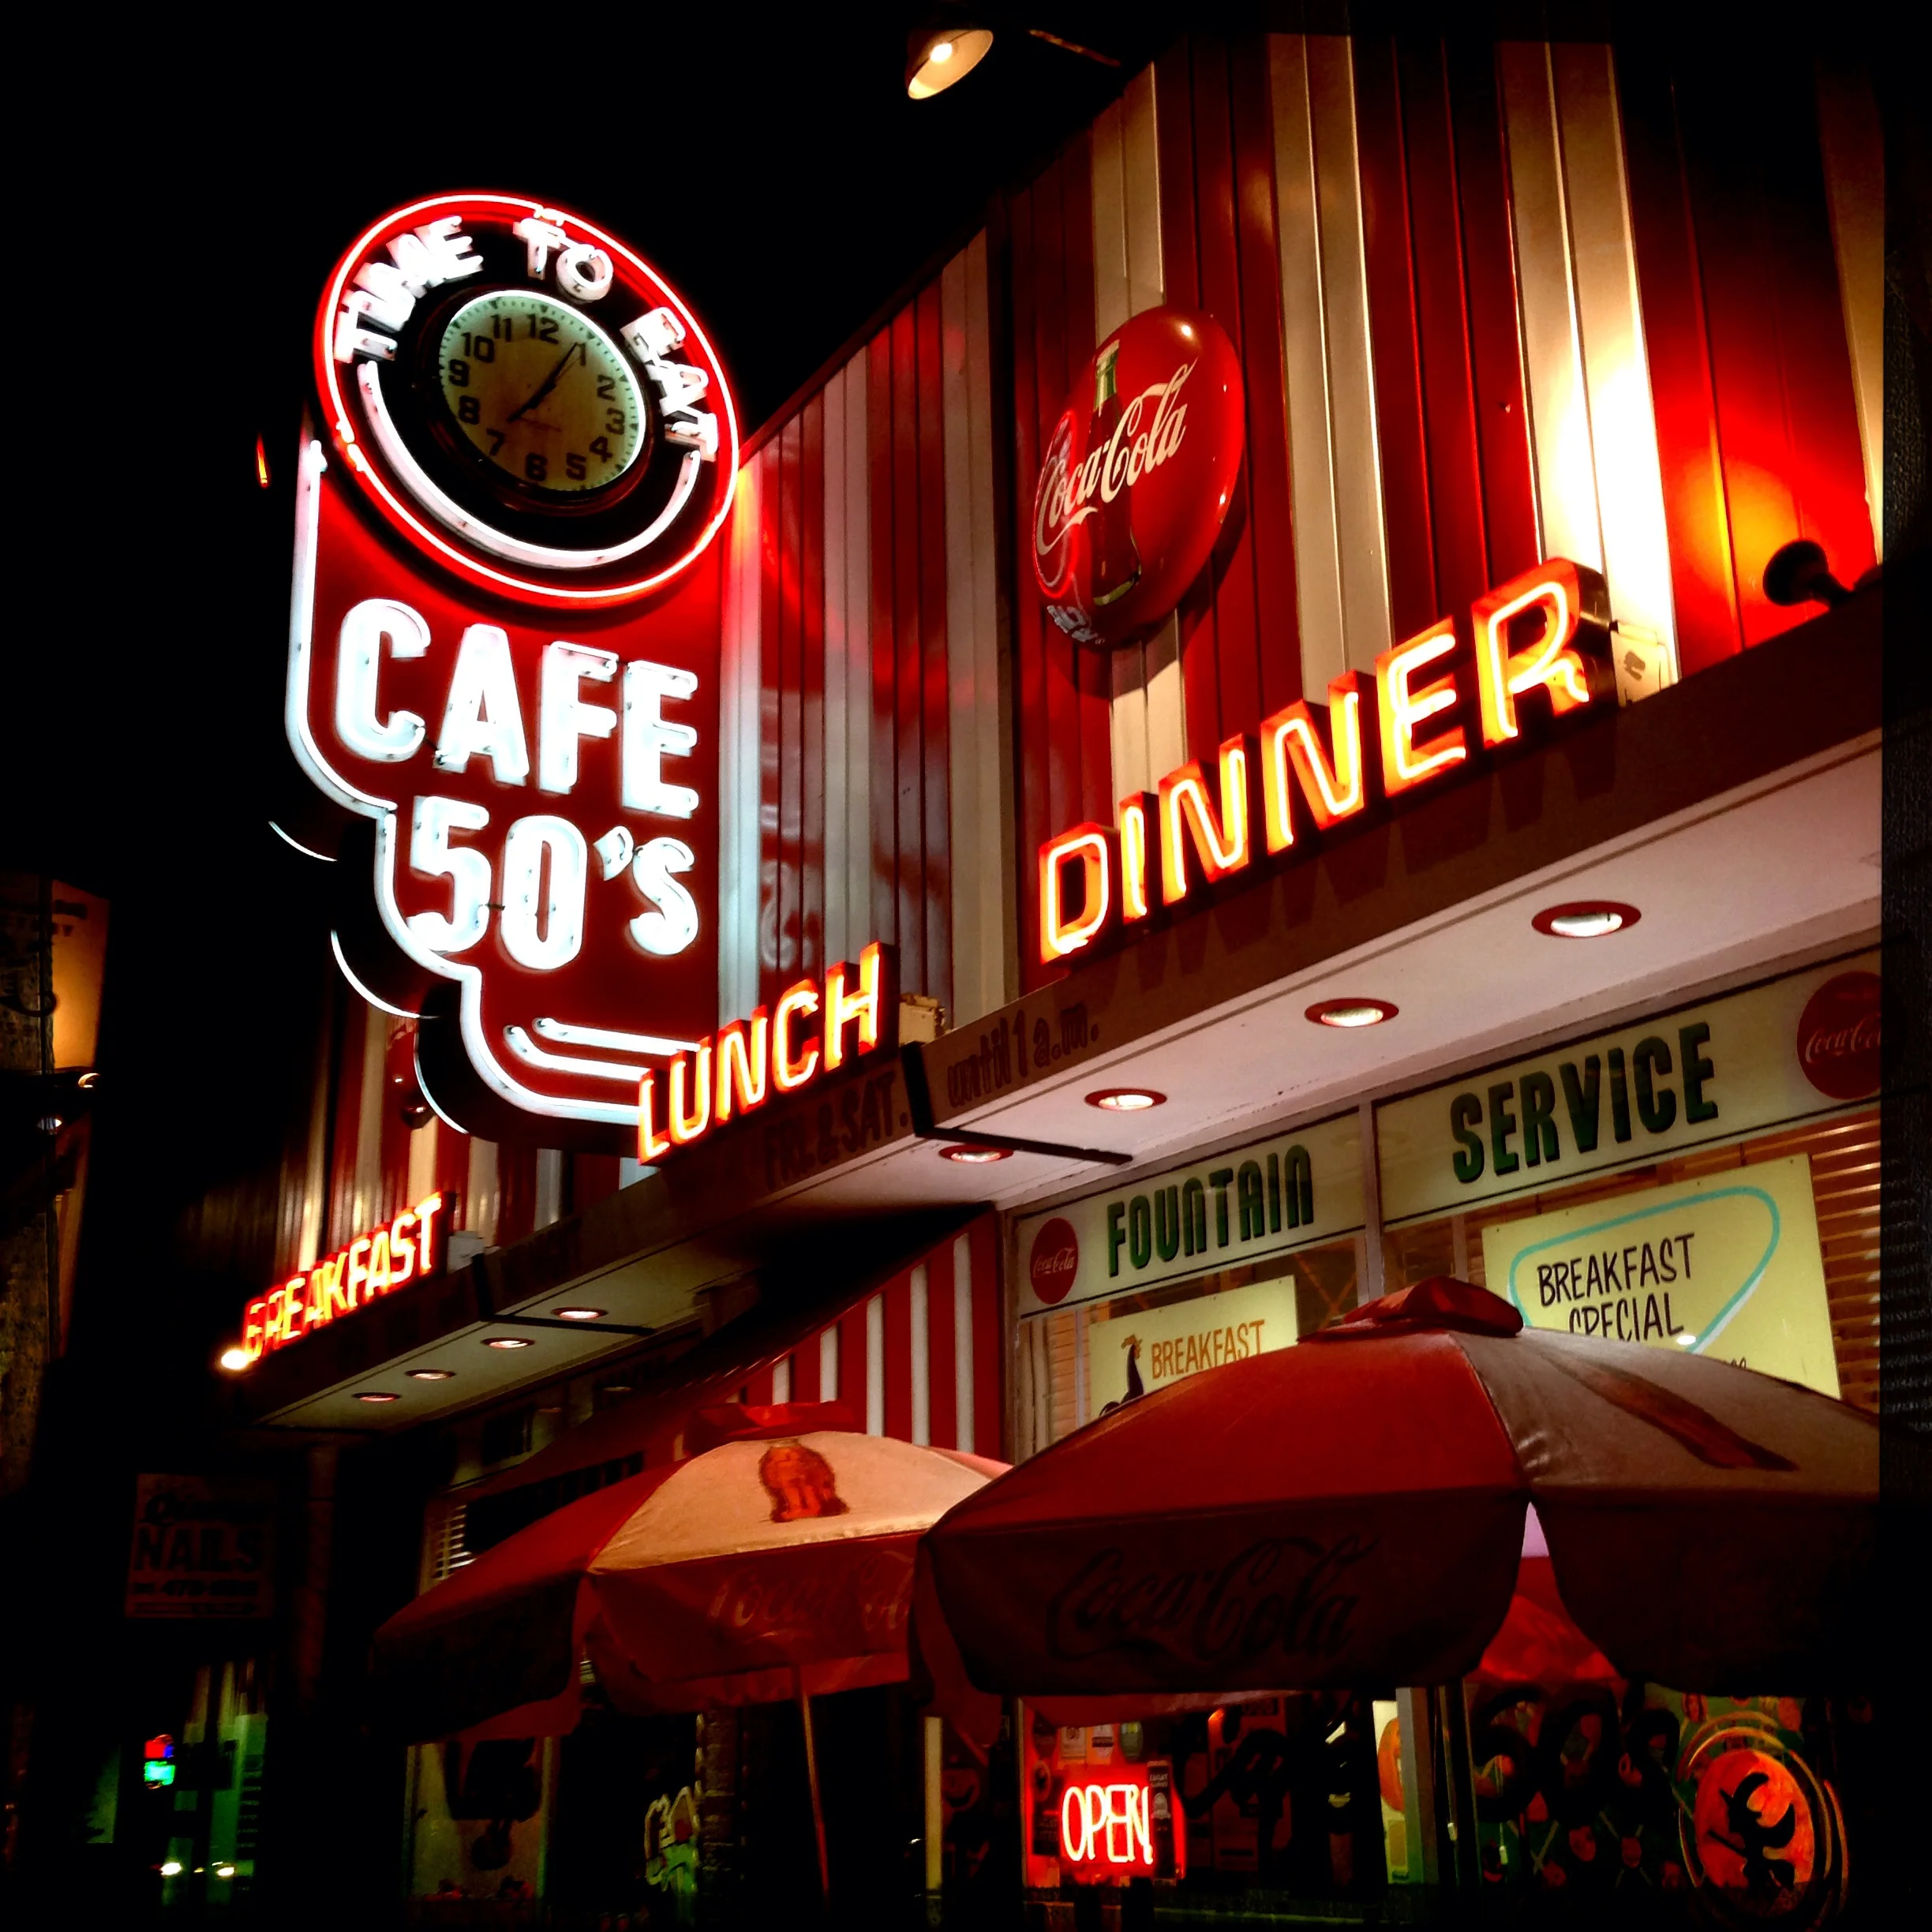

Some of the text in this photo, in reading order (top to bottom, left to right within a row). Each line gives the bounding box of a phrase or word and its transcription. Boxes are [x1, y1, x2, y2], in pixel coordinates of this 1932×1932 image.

[335, 215, 718, 461] TIME TO EAT
[461, 331, 495, 363] 10
[490, 313, 512, 342] 11
[526, 313, 560, 345] 12
[449, 359, 470, 388] 9
[597, 373, 616, 402] 2
[459, 395, 480, 425] 8
[605, 407, 625, 436] 3
[486, 428, 505, 456] 7
[525, 452, 548, 482] 6
[565, 452, 586, 481] 5
[589, 436, 613, 463] 4
[1036, 354, 1198, 556] Coca-Cola
[335, 597, 700, 821] CAFE
[1039, 556, 1589, 966] DINNER
[403, 796, 700, 970] 50'S
[638, 941, 880, 1165] LUNCH
[947, 1017, 1011, 1107] until
[1450, 1022, 1719, 1183] SERVICE
[1106, 1144, 1314, 1278] FOUNTAIN
[243, 1191, 441, 1361] BREAKFAST
[1032, 1246, 1076, 1278] Coca-Cola
[1537, 1233, 1694, 1307] BREAKFAST
[1151, 1320, 1264, 1380] BREAKFAST
[134, 1528, 263, 1572] NAILS
[1046, 1534, 1383, 1657] Coca-Cola
[1061, 1784, 1154, 1865] OPEN
